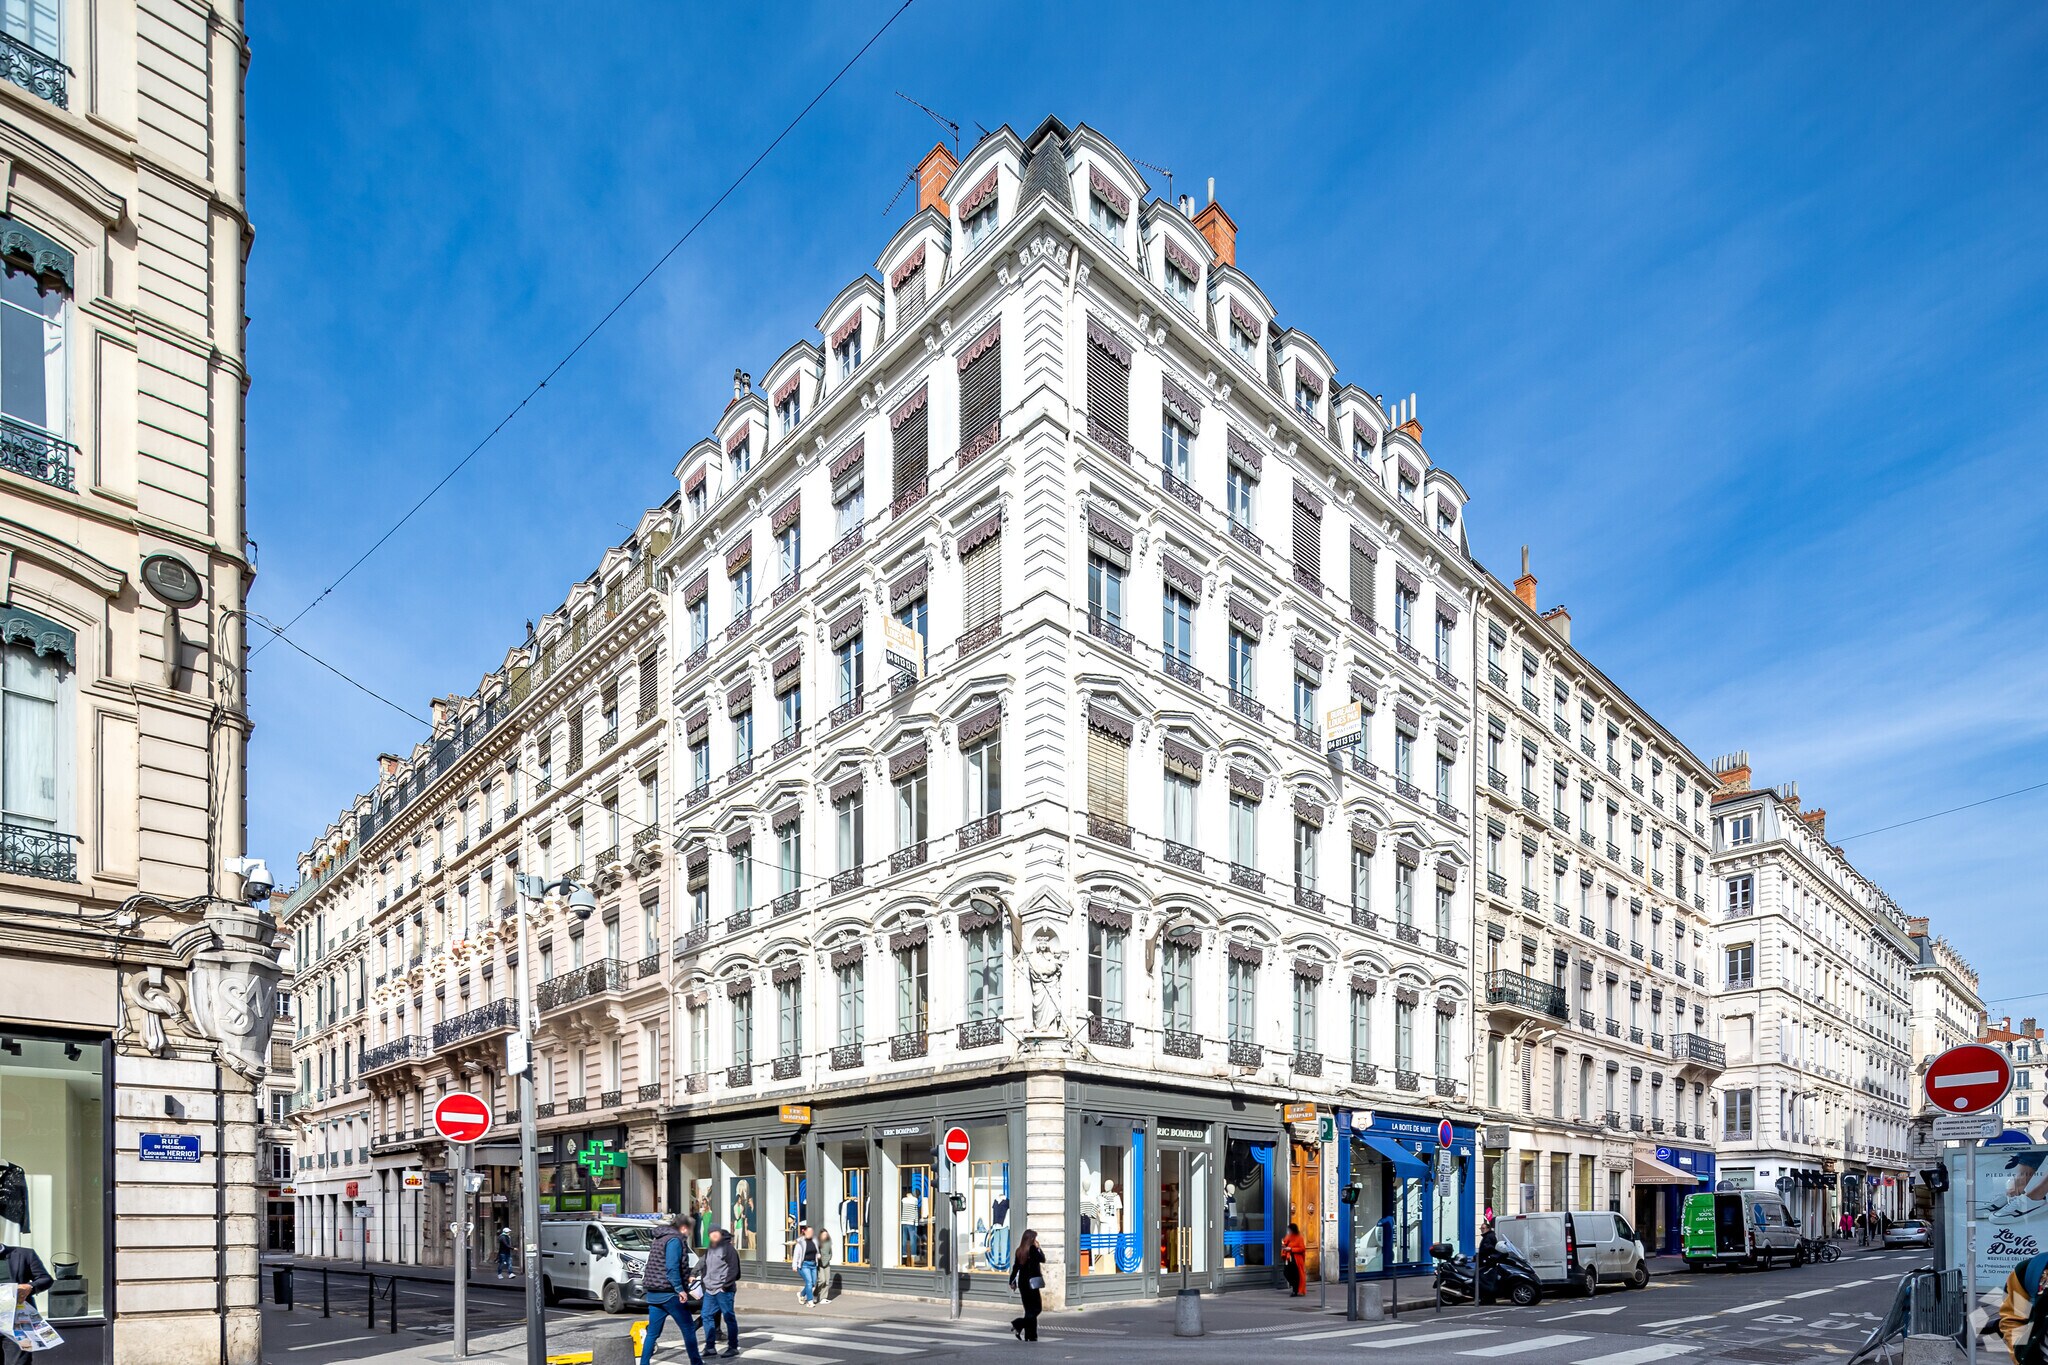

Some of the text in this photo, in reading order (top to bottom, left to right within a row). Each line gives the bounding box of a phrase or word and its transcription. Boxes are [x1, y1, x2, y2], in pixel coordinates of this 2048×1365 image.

[1156, 1128, 1203, 1138] RIC BOMPARD
[1993, 1228, 2038, 1247] La Vie
[1987, 1242, 2040, 1255] Douce
